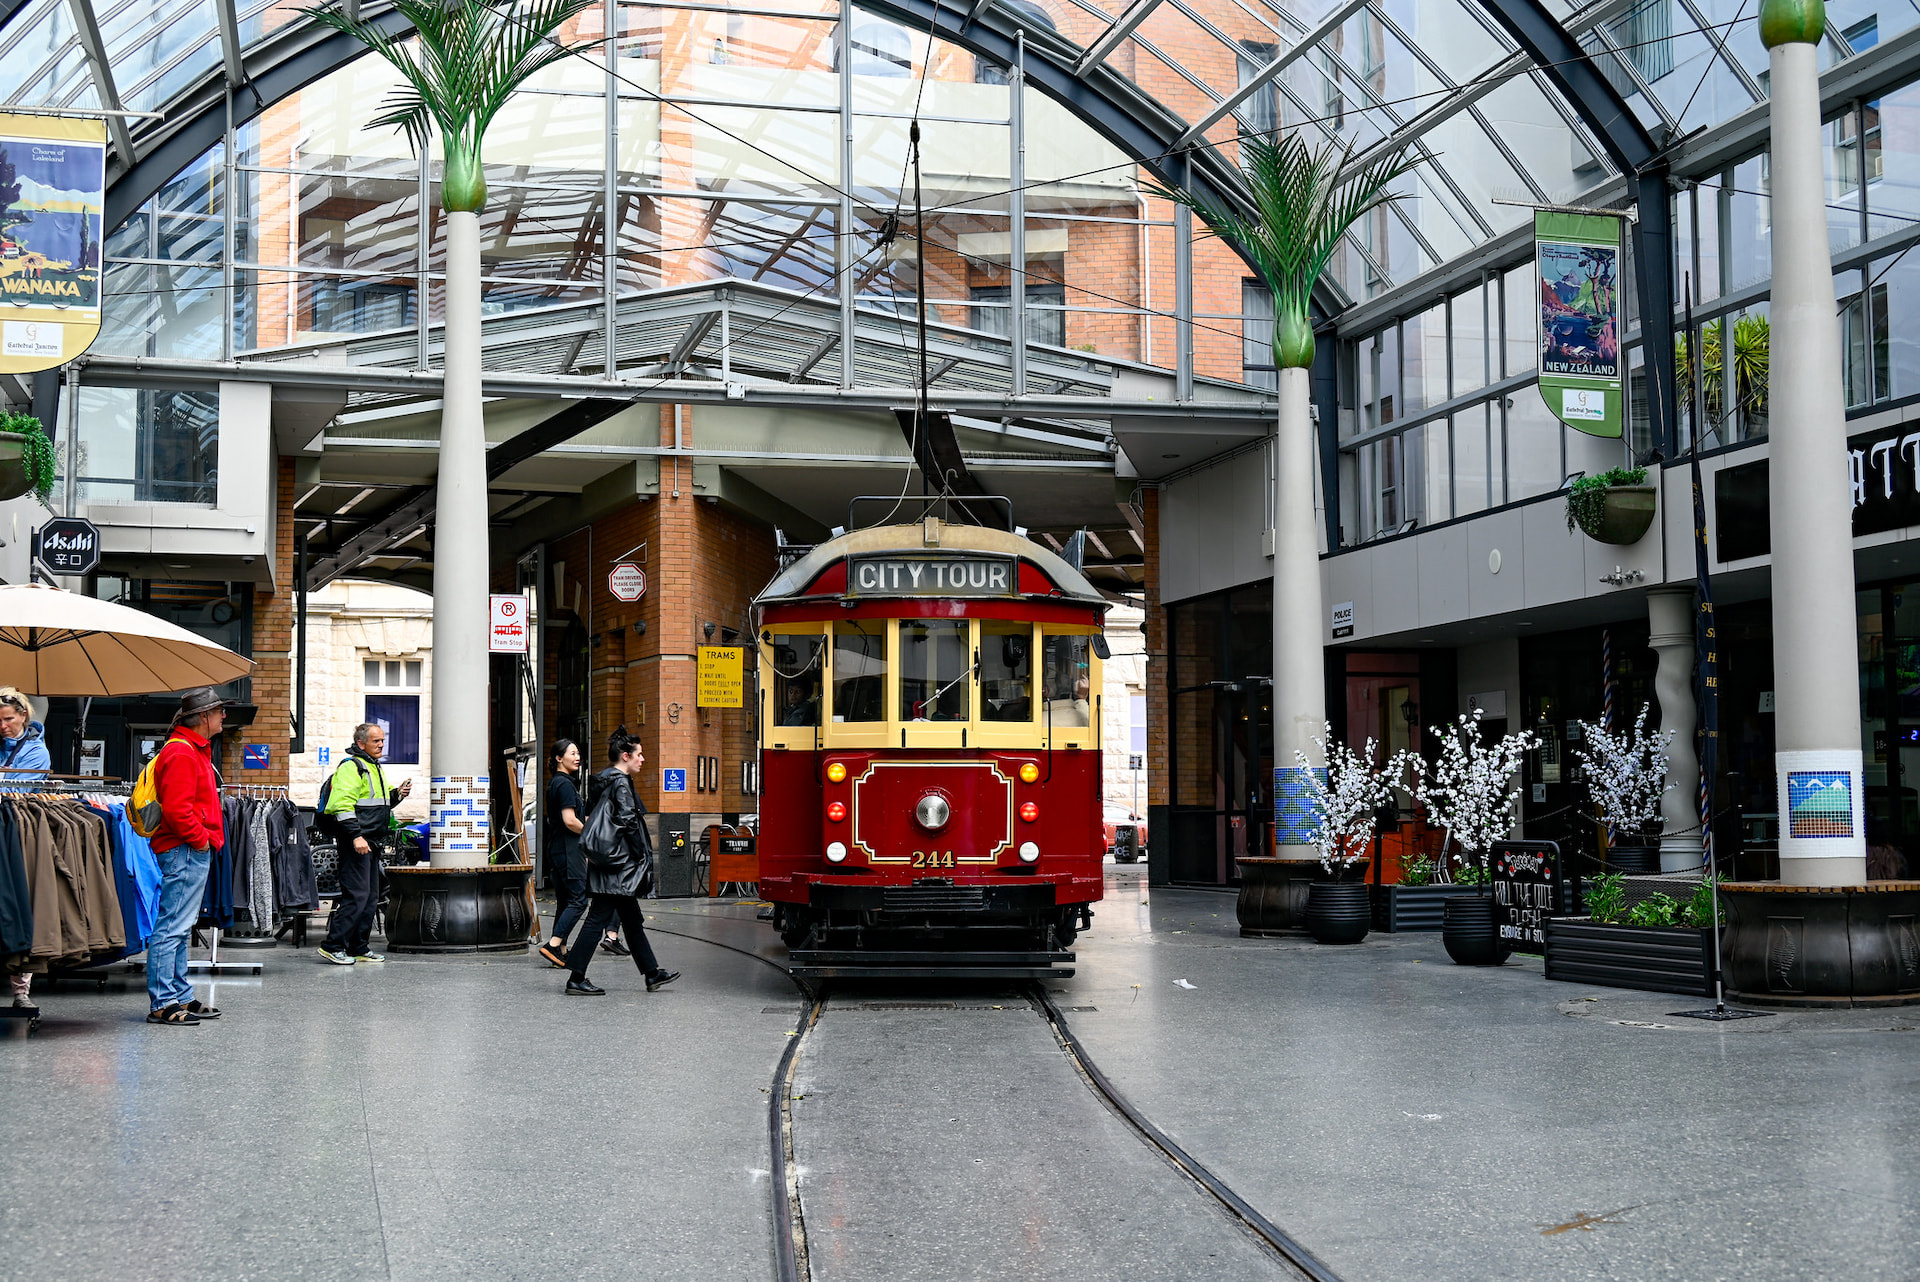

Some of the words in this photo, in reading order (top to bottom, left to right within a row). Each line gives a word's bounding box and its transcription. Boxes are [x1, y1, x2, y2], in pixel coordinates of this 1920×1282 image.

[32, 147, 56, 155] Charm
[32, 154, 65, 162] Lakeland
[2, 278, 81, 297] WANAKA
[1546, 361, 1569, 372] NEW
[1570, 362, 1615, 375] ZEALAND
[44, 531, 93, 551] Asahi
[859, 563, 925, 589] CITY
[931, 563, 1006, 589] TOUR
[1334, 608, 1351, 620] POLICE
[706, 651, 735, 660] TRAMS
[912, 850, 955, 868] 244
[1495, 881, 1514, 906] ROLL
[1513, 882, 1532, 907] THE
[1533, 883, 1554, 910] DICE
[1525, 928, 1531, 940] IN
